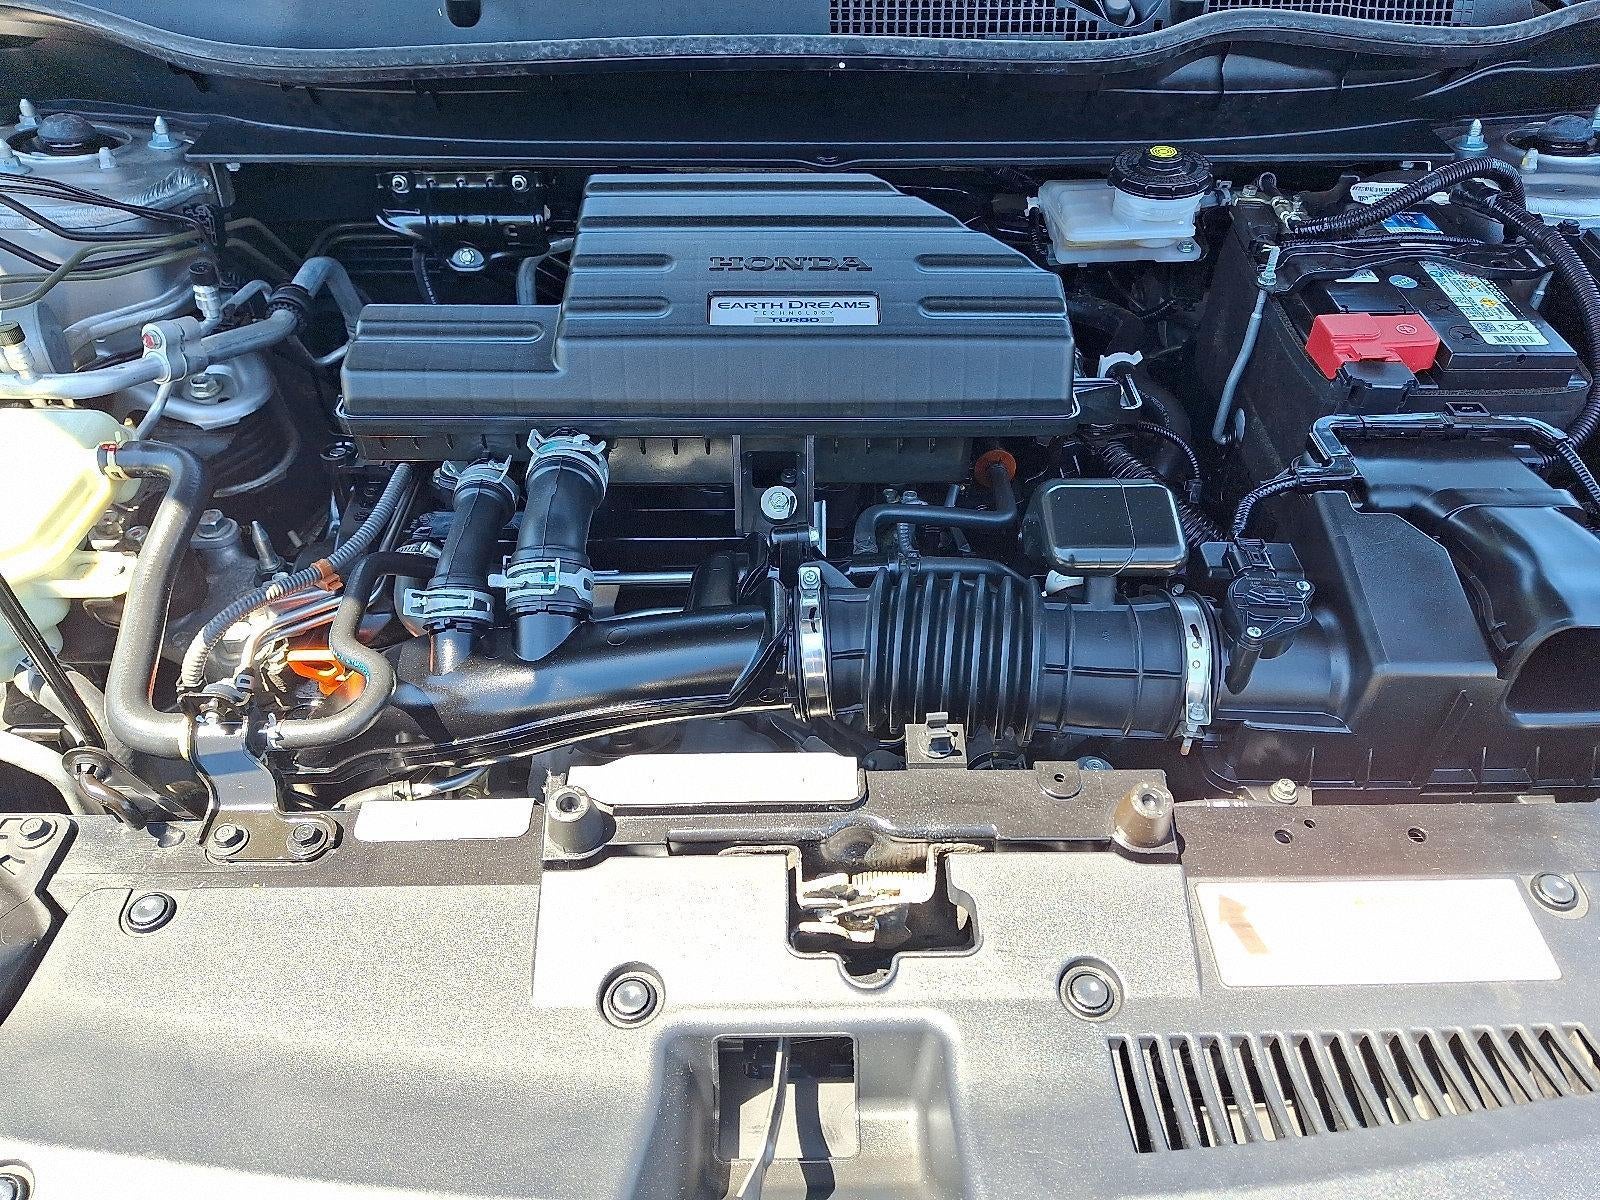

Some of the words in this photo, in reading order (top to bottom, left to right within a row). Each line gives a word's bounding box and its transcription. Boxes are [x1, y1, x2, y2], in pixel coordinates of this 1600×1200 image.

[708, 256, 873, 272] HONDA
[717, 301, 784, 309] EARTH
[788, 300, 871, 309] DREAMS
